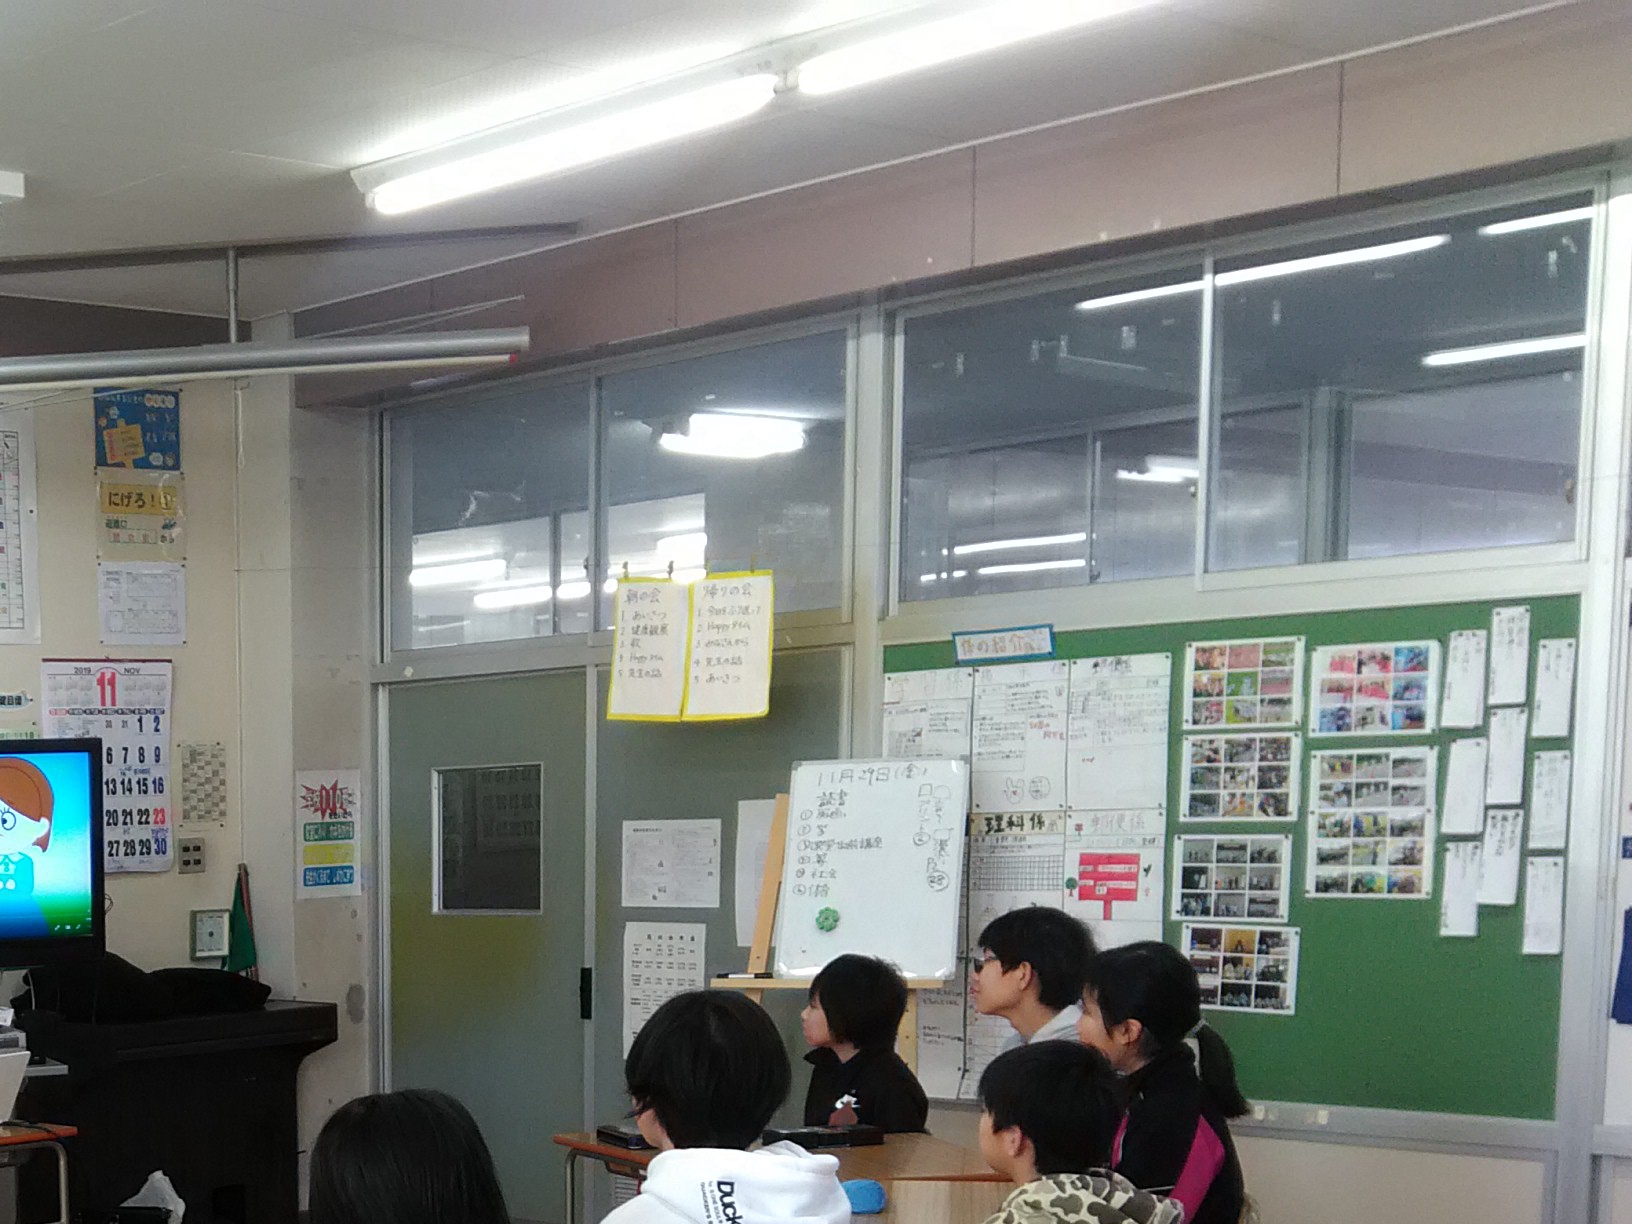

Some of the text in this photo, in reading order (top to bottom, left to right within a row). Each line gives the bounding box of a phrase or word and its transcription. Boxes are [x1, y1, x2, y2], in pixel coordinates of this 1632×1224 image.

[96, 672, 116, 707] 11
[137, 716, 143, 732] 1
[153, 716, 160, 732] 2
[106, 746, 161, 764] 6 7 8 9
[105, 777, 164, 795] 13 14 15 16
[106, 808, 166, 826] 20 21 22 23
[984, 813, 1045, 834] 理科係
[108, 839, 167, 857] 27 28 29 30
